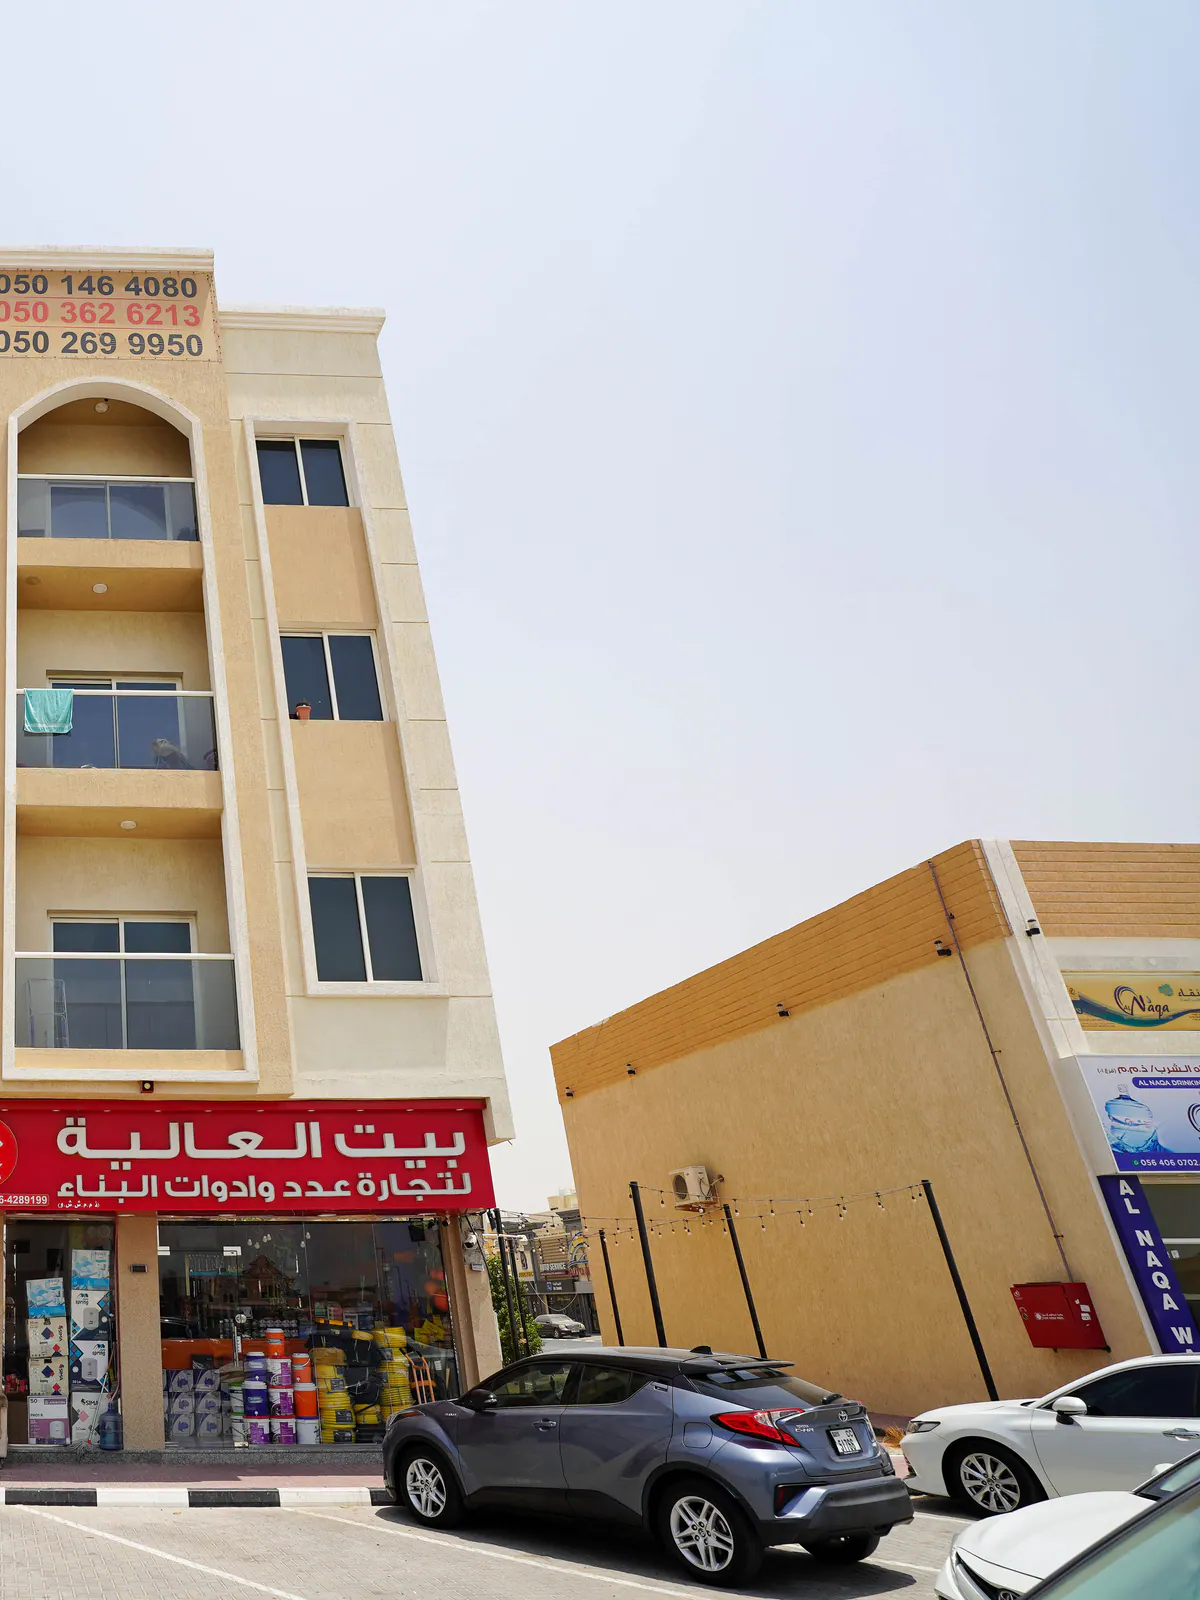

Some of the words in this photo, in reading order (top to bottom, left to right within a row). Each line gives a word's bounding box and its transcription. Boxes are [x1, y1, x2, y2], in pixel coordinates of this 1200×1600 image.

[61, 275, 114, 295] 146
[125, 276, 197, 298] 4080
[60, 302, 115, 324] 362
[127, 303, 200, 327] 6213
[61, 331, 116, 355] 269
[128, 333, 203, 356] 9950
[56, 1117, 322, 1170] العالية
[334, 1124, 466, 1169] بيت
[57, 1174, 158, 1203] البناء
[164, 1174, 275, 1203] وادوات
[283, 1179, 351, 1197] عدد
[356, 1172, 472, 1201] لتجارة
[1119, 1179, 1140, 1214] AL
[1135, 1230, 1179, 1311] NAQA
